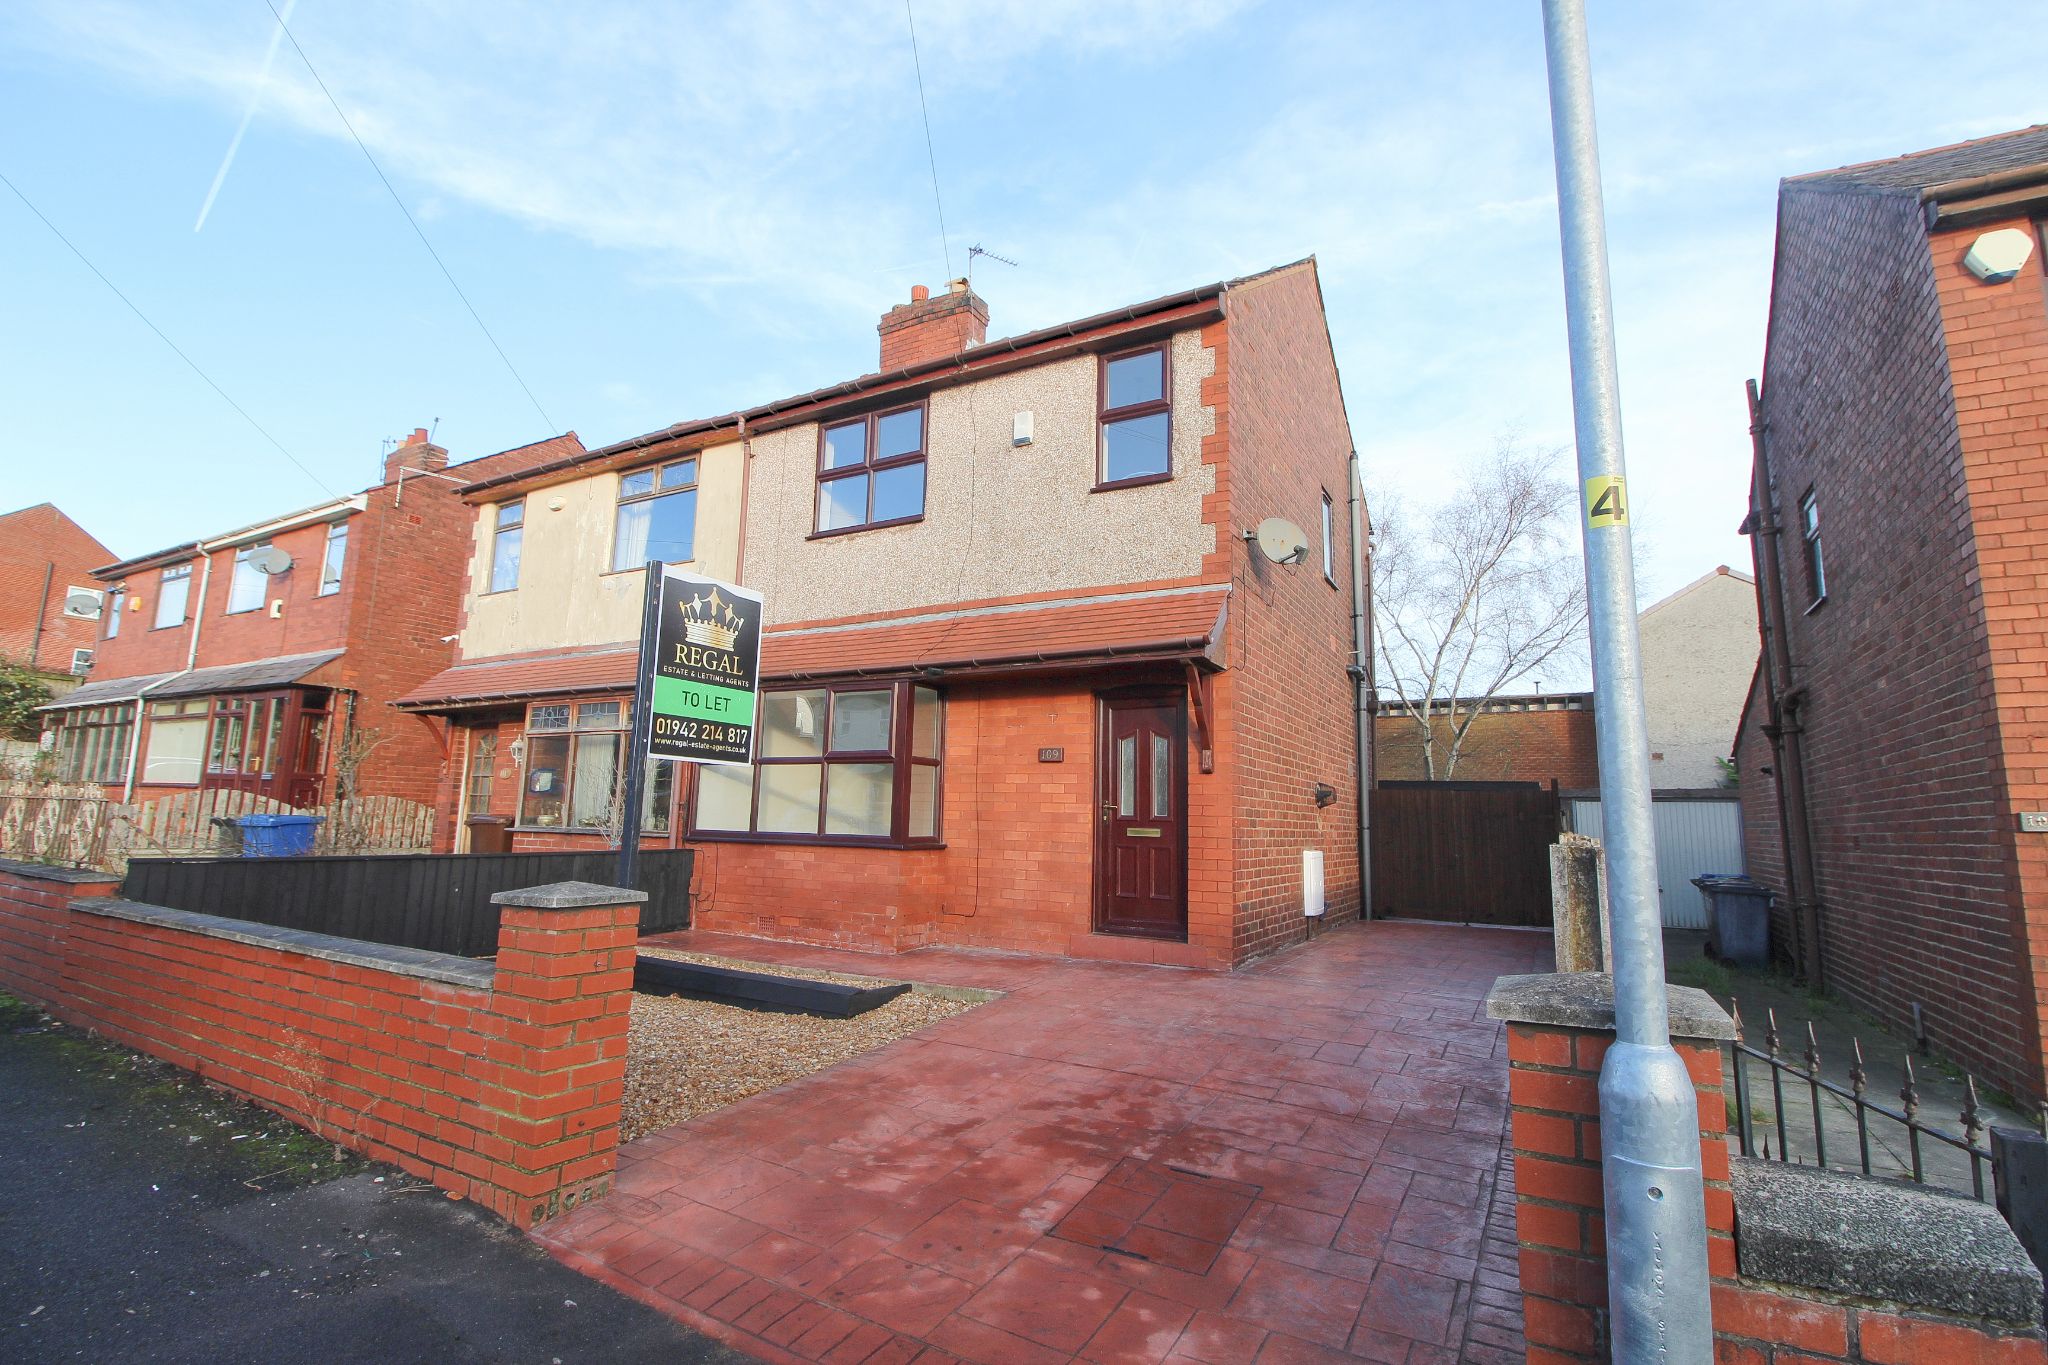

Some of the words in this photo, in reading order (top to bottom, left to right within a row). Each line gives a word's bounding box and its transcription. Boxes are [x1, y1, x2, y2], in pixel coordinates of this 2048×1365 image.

[1591, 486, 1624, 520] 4
[673, 643, 744, 676] REGAL
[663, 665, 688, 676] ESTATE
[697, 671, 724, 683] LETTING
[725, 677, 749, 688] AGENTS
[682, 690, 700, 708] TO
[705, 694, 731, 712] LET
[656, 717, 697, 738] 01942
[701, 724, 723, 741] 214
[727, 727, 748, 744] 817
[654, 737, 747, 754] www.regal-estate-agents.co.uk
